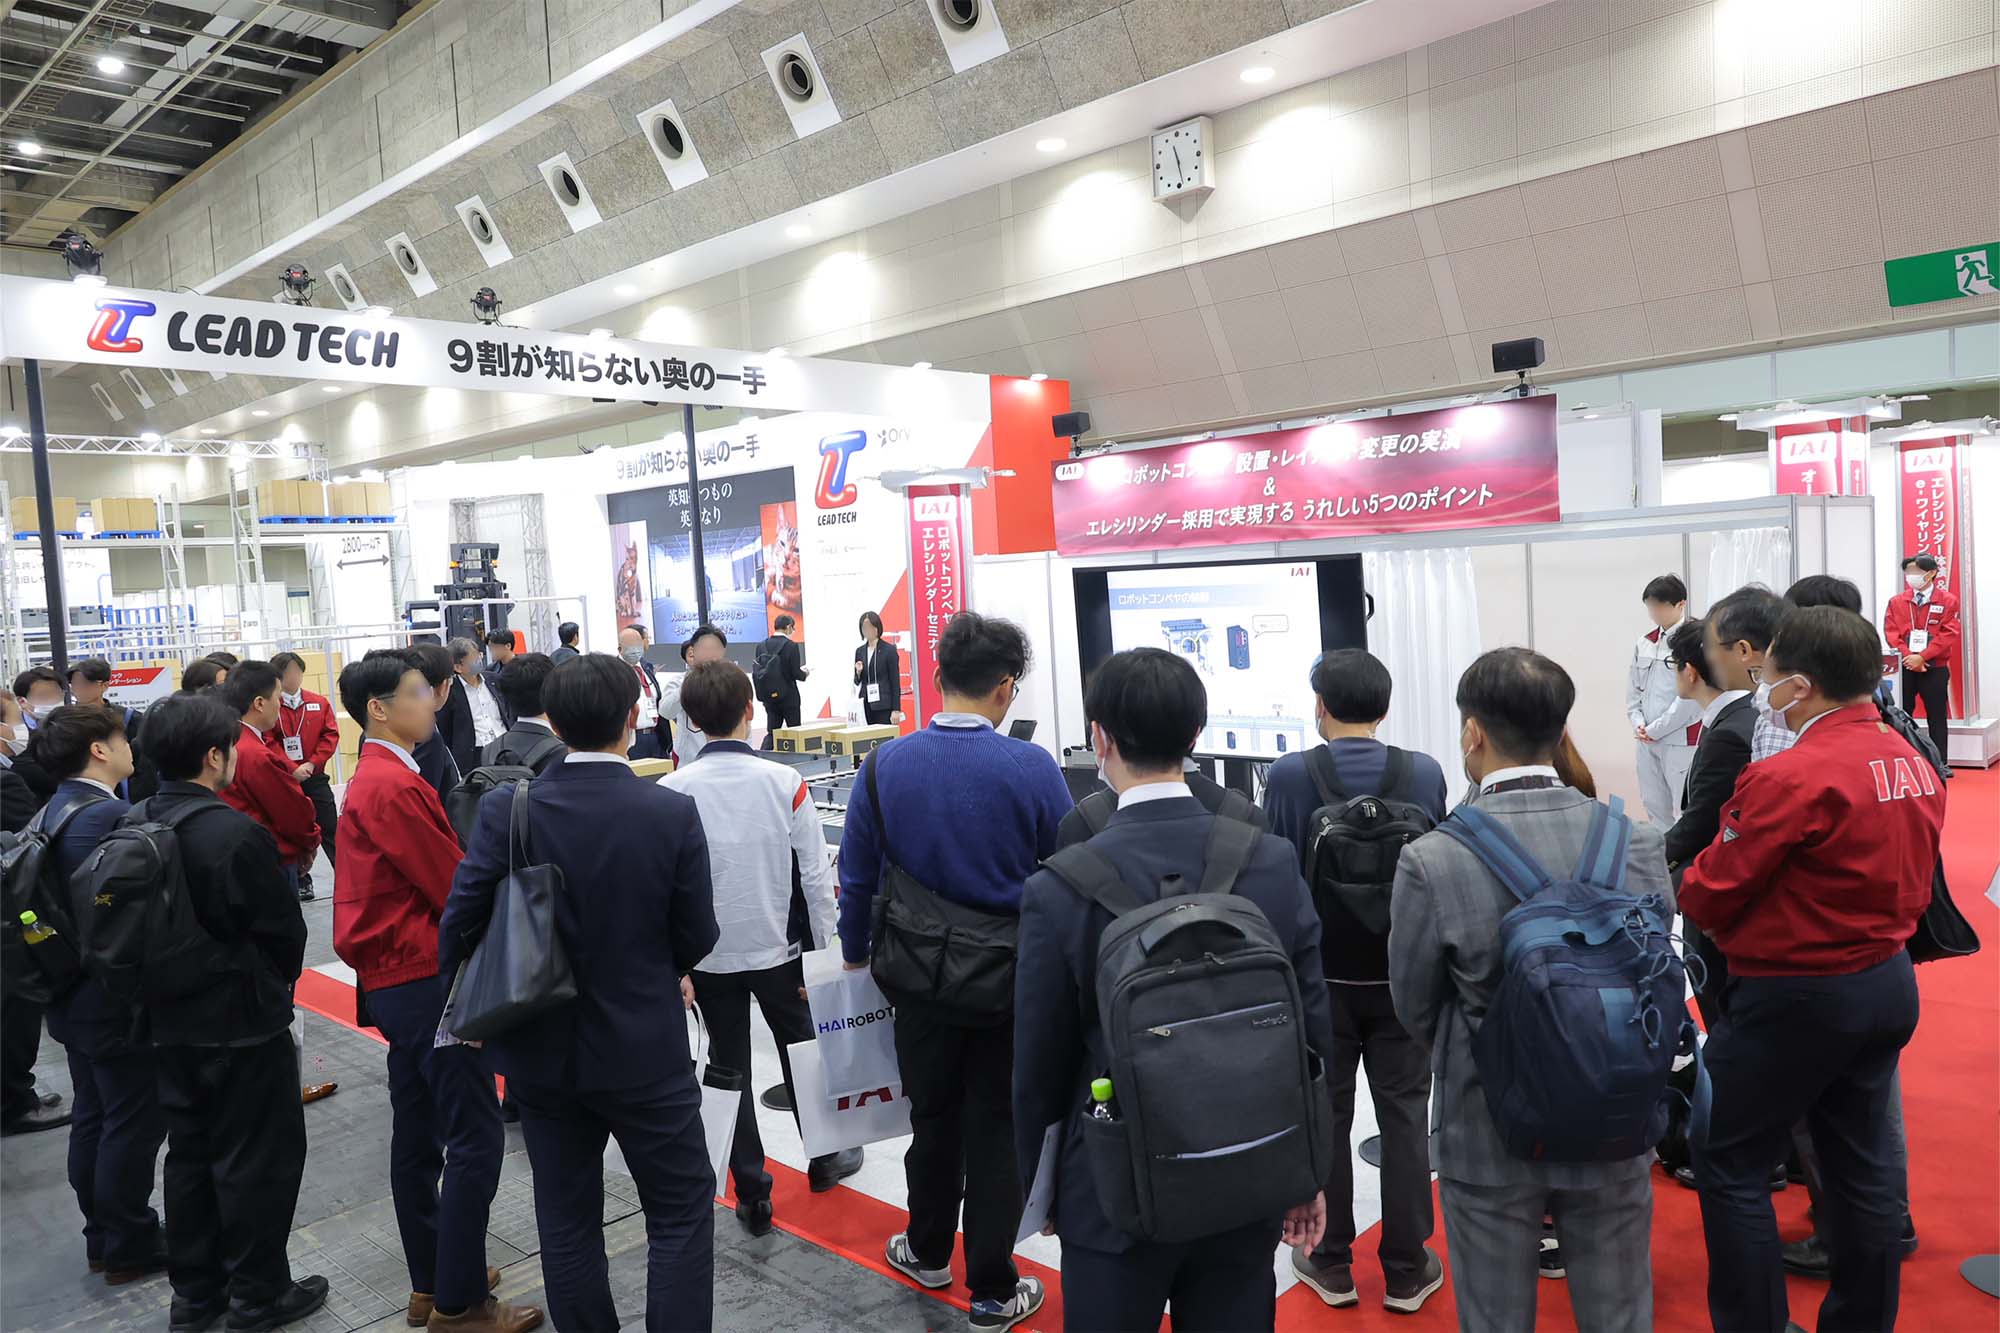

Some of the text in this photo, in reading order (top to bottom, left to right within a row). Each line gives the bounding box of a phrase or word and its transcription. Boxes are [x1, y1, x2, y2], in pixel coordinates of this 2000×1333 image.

[167, 311, 400, 369] LEAD TECH
[447, 338, 767, 396] 9割が知らない奥の一手
[1790, 439, 1828, 457] IAI
[1062, 466, 1077, 476] IAI
[1913, 453, 1944, 467] IAI
[668, 482, 732, 507] 英知つもの
[1263, 476, 1277, 496] &
[680, 505, 721, 528] 英なり
[818, 512, 857, 526] LEAD TECH
[921, 502, 950, 515] IAI
[1086, 483, 1494, 536] エレシリンダー採用で実現する うれしい5つのポイント
[1290, 567, 1310, 577] IAI
[922, 527, 940, 662] エレシリンダーセミナー
[1868, 756, 1936, 802] IAI
[818, 1006, 895, 1034] HAIROBOT
